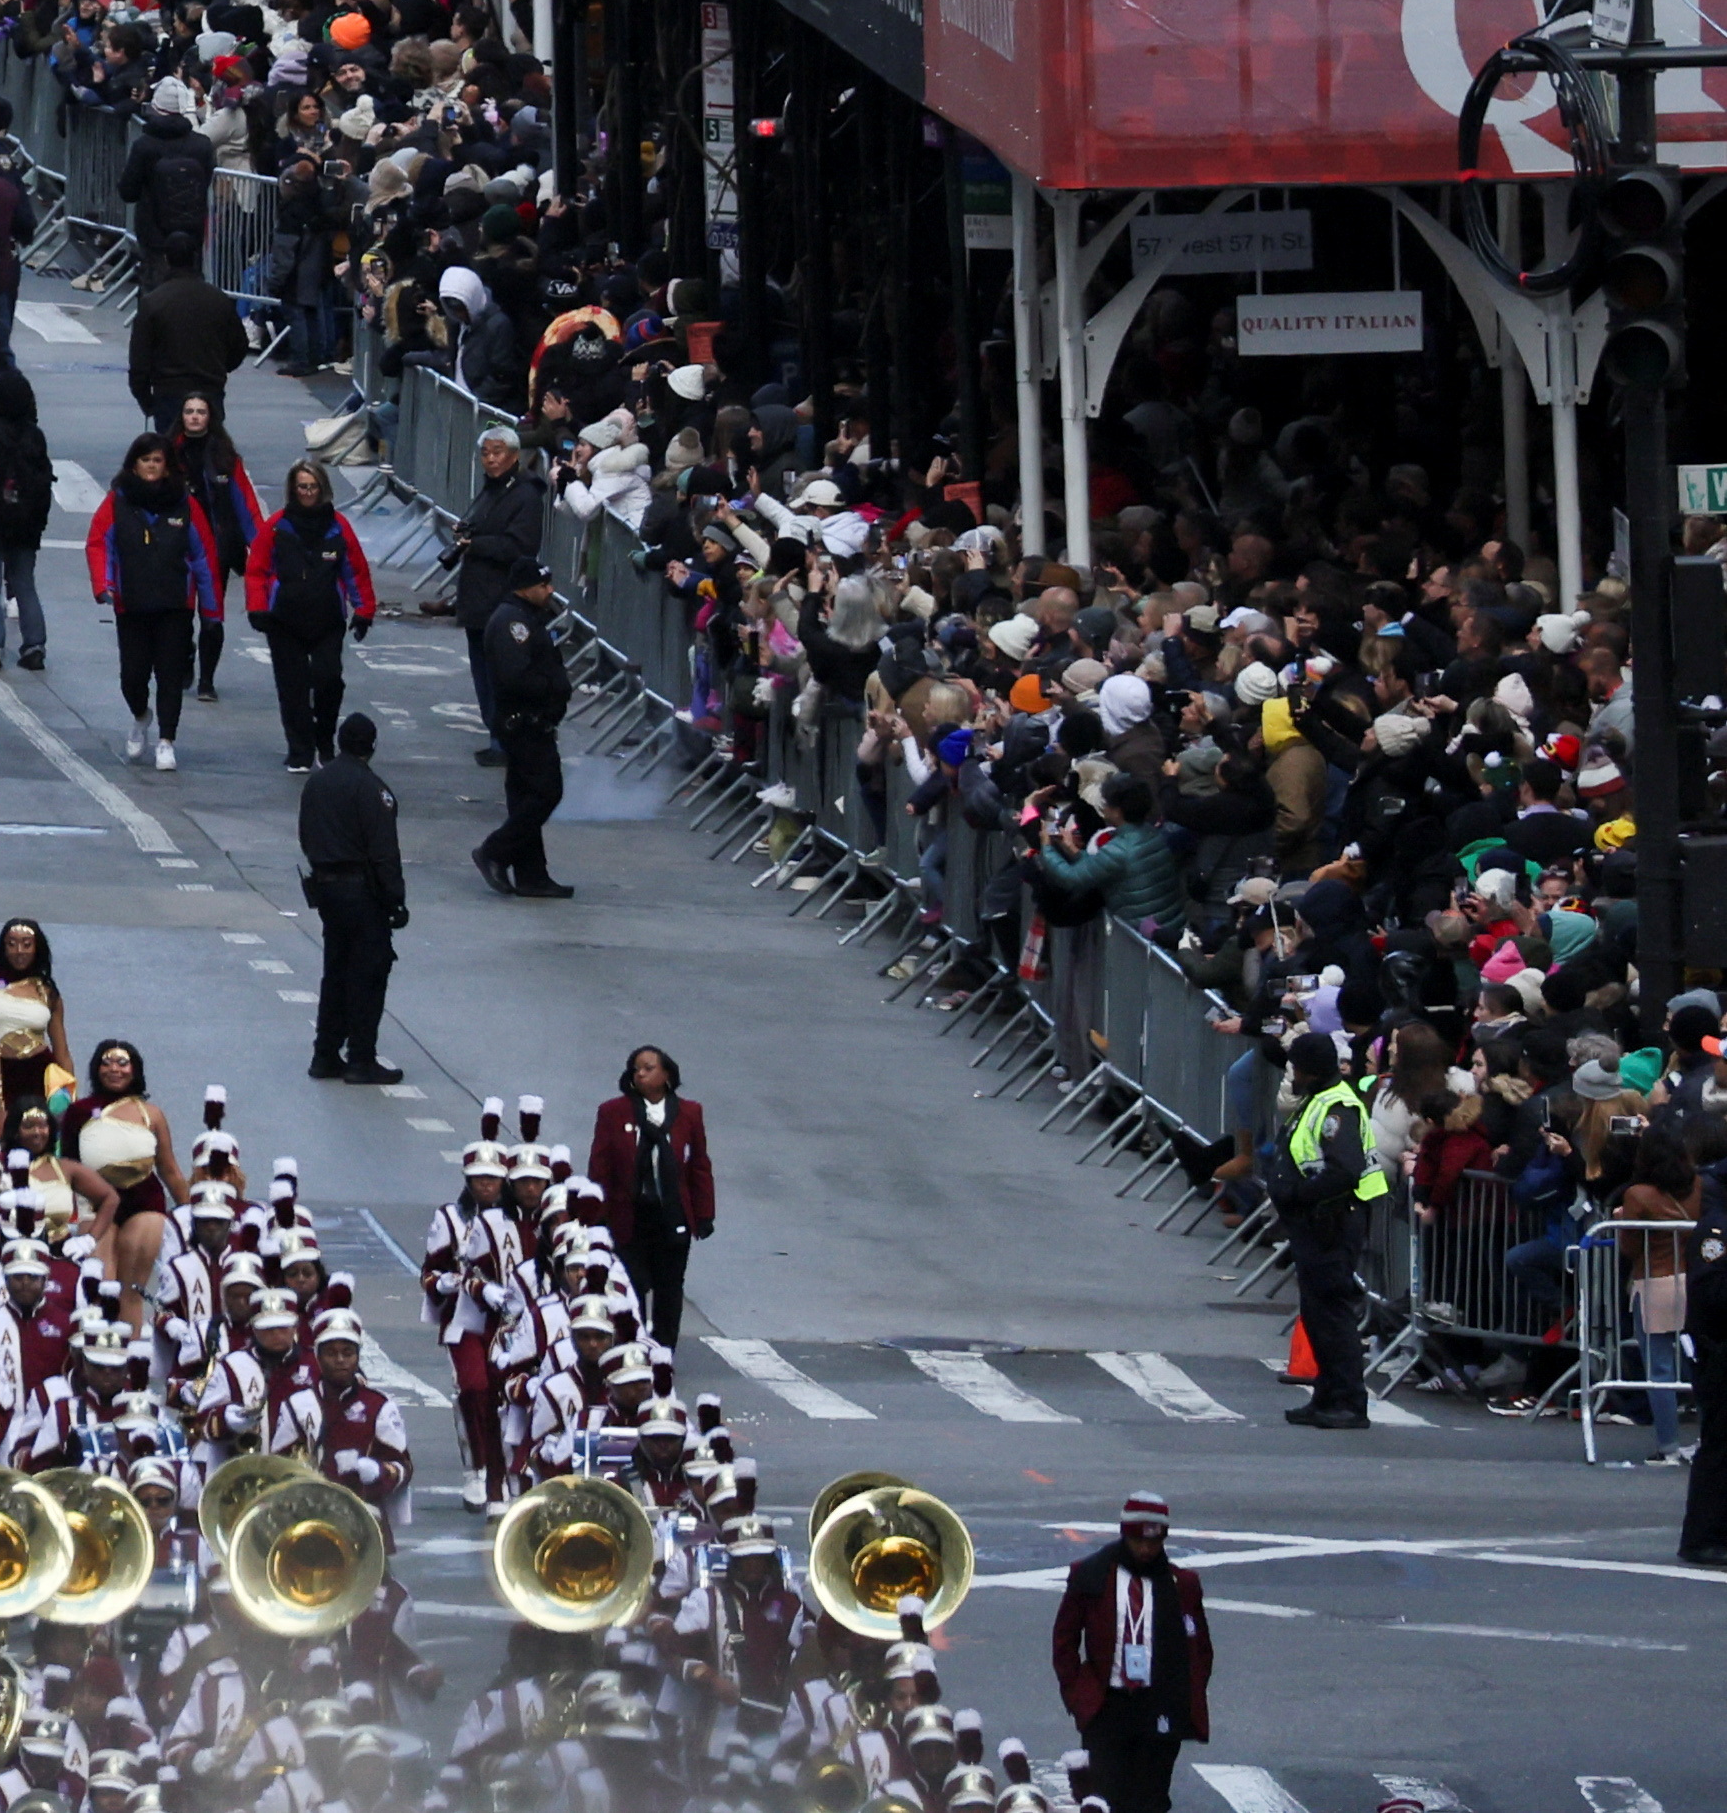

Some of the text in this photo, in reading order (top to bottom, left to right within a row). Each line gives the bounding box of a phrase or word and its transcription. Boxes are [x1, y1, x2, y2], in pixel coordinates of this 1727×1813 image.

[705, 5, 714, 28] 3
[708, 122, 717, 140] 5
[1137, 238, 1162, 257] 57
[1241, 315, 1417, 335] QUALITY ITALIAN
